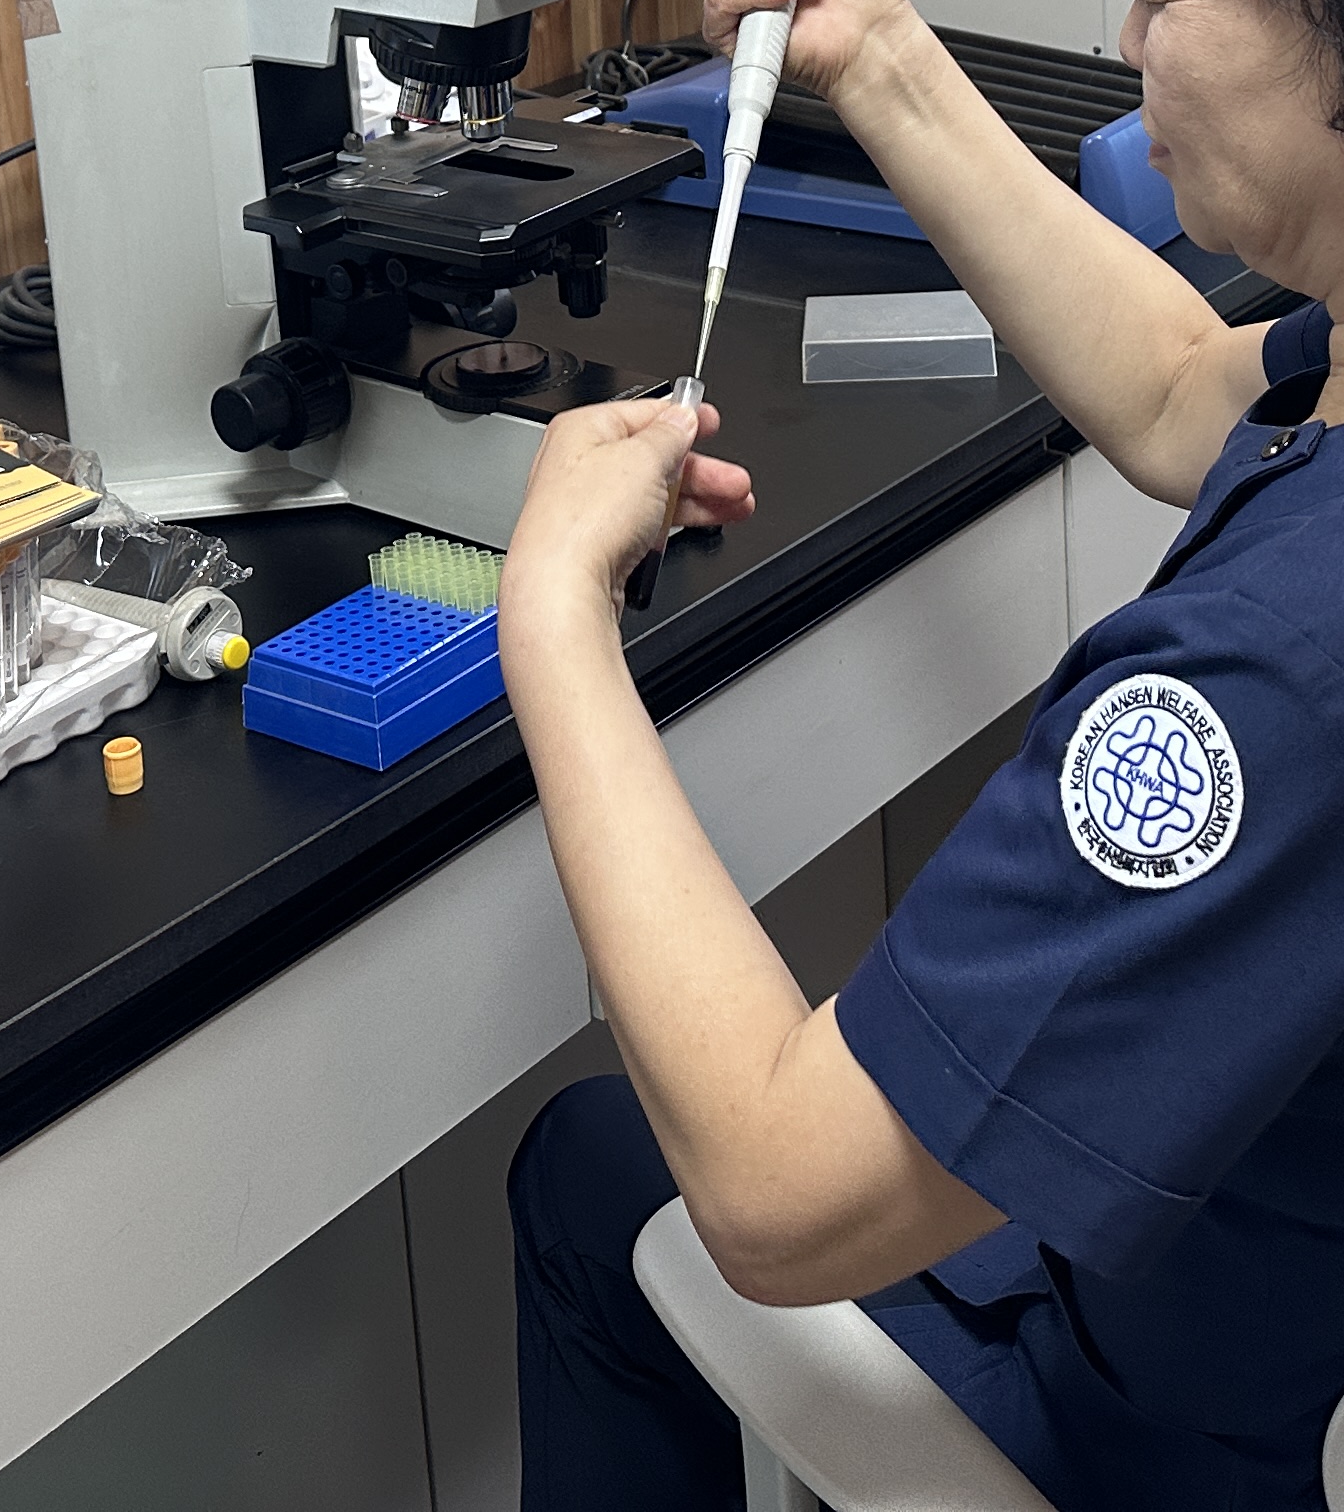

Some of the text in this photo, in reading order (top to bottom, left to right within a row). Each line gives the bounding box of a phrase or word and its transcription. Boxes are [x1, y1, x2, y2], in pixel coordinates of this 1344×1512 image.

[1070, 686, 1234, 857] KOREAN HANSEN WELFARE ASSOCIATION
[1126, 765, 1165, 799] KHWA
